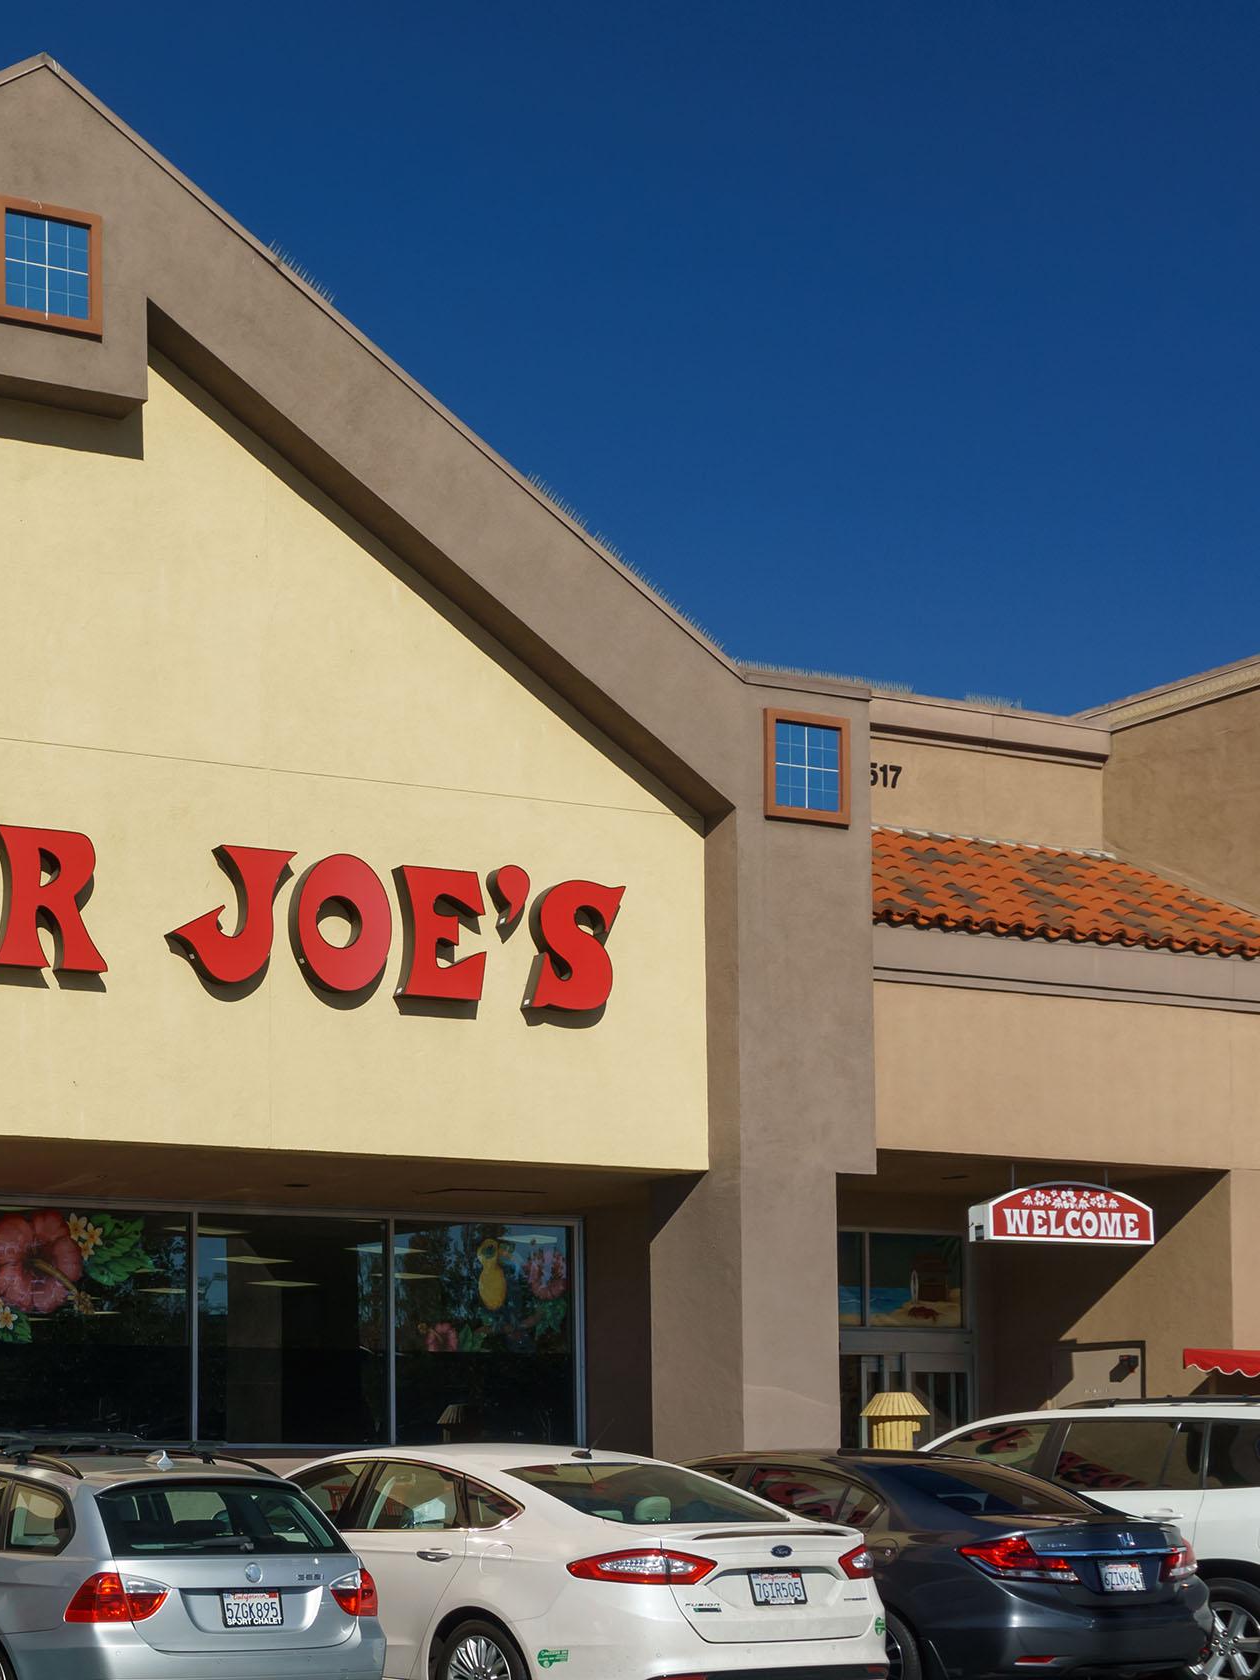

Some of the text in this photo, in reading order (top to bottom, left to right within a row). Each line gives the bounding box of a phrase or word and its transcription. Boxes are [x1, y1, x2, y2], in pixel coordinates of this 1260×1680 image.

[164, 845, 626, 1014] JOE'S
[1002, 1208, 1139, 1238] WELCOME
[755, 1582, 803, 1600] 7GIR505
[225, 1601, 279, 1619] 5ZGK895
[227, 1616, 283, 1626] SPORT CHALET
